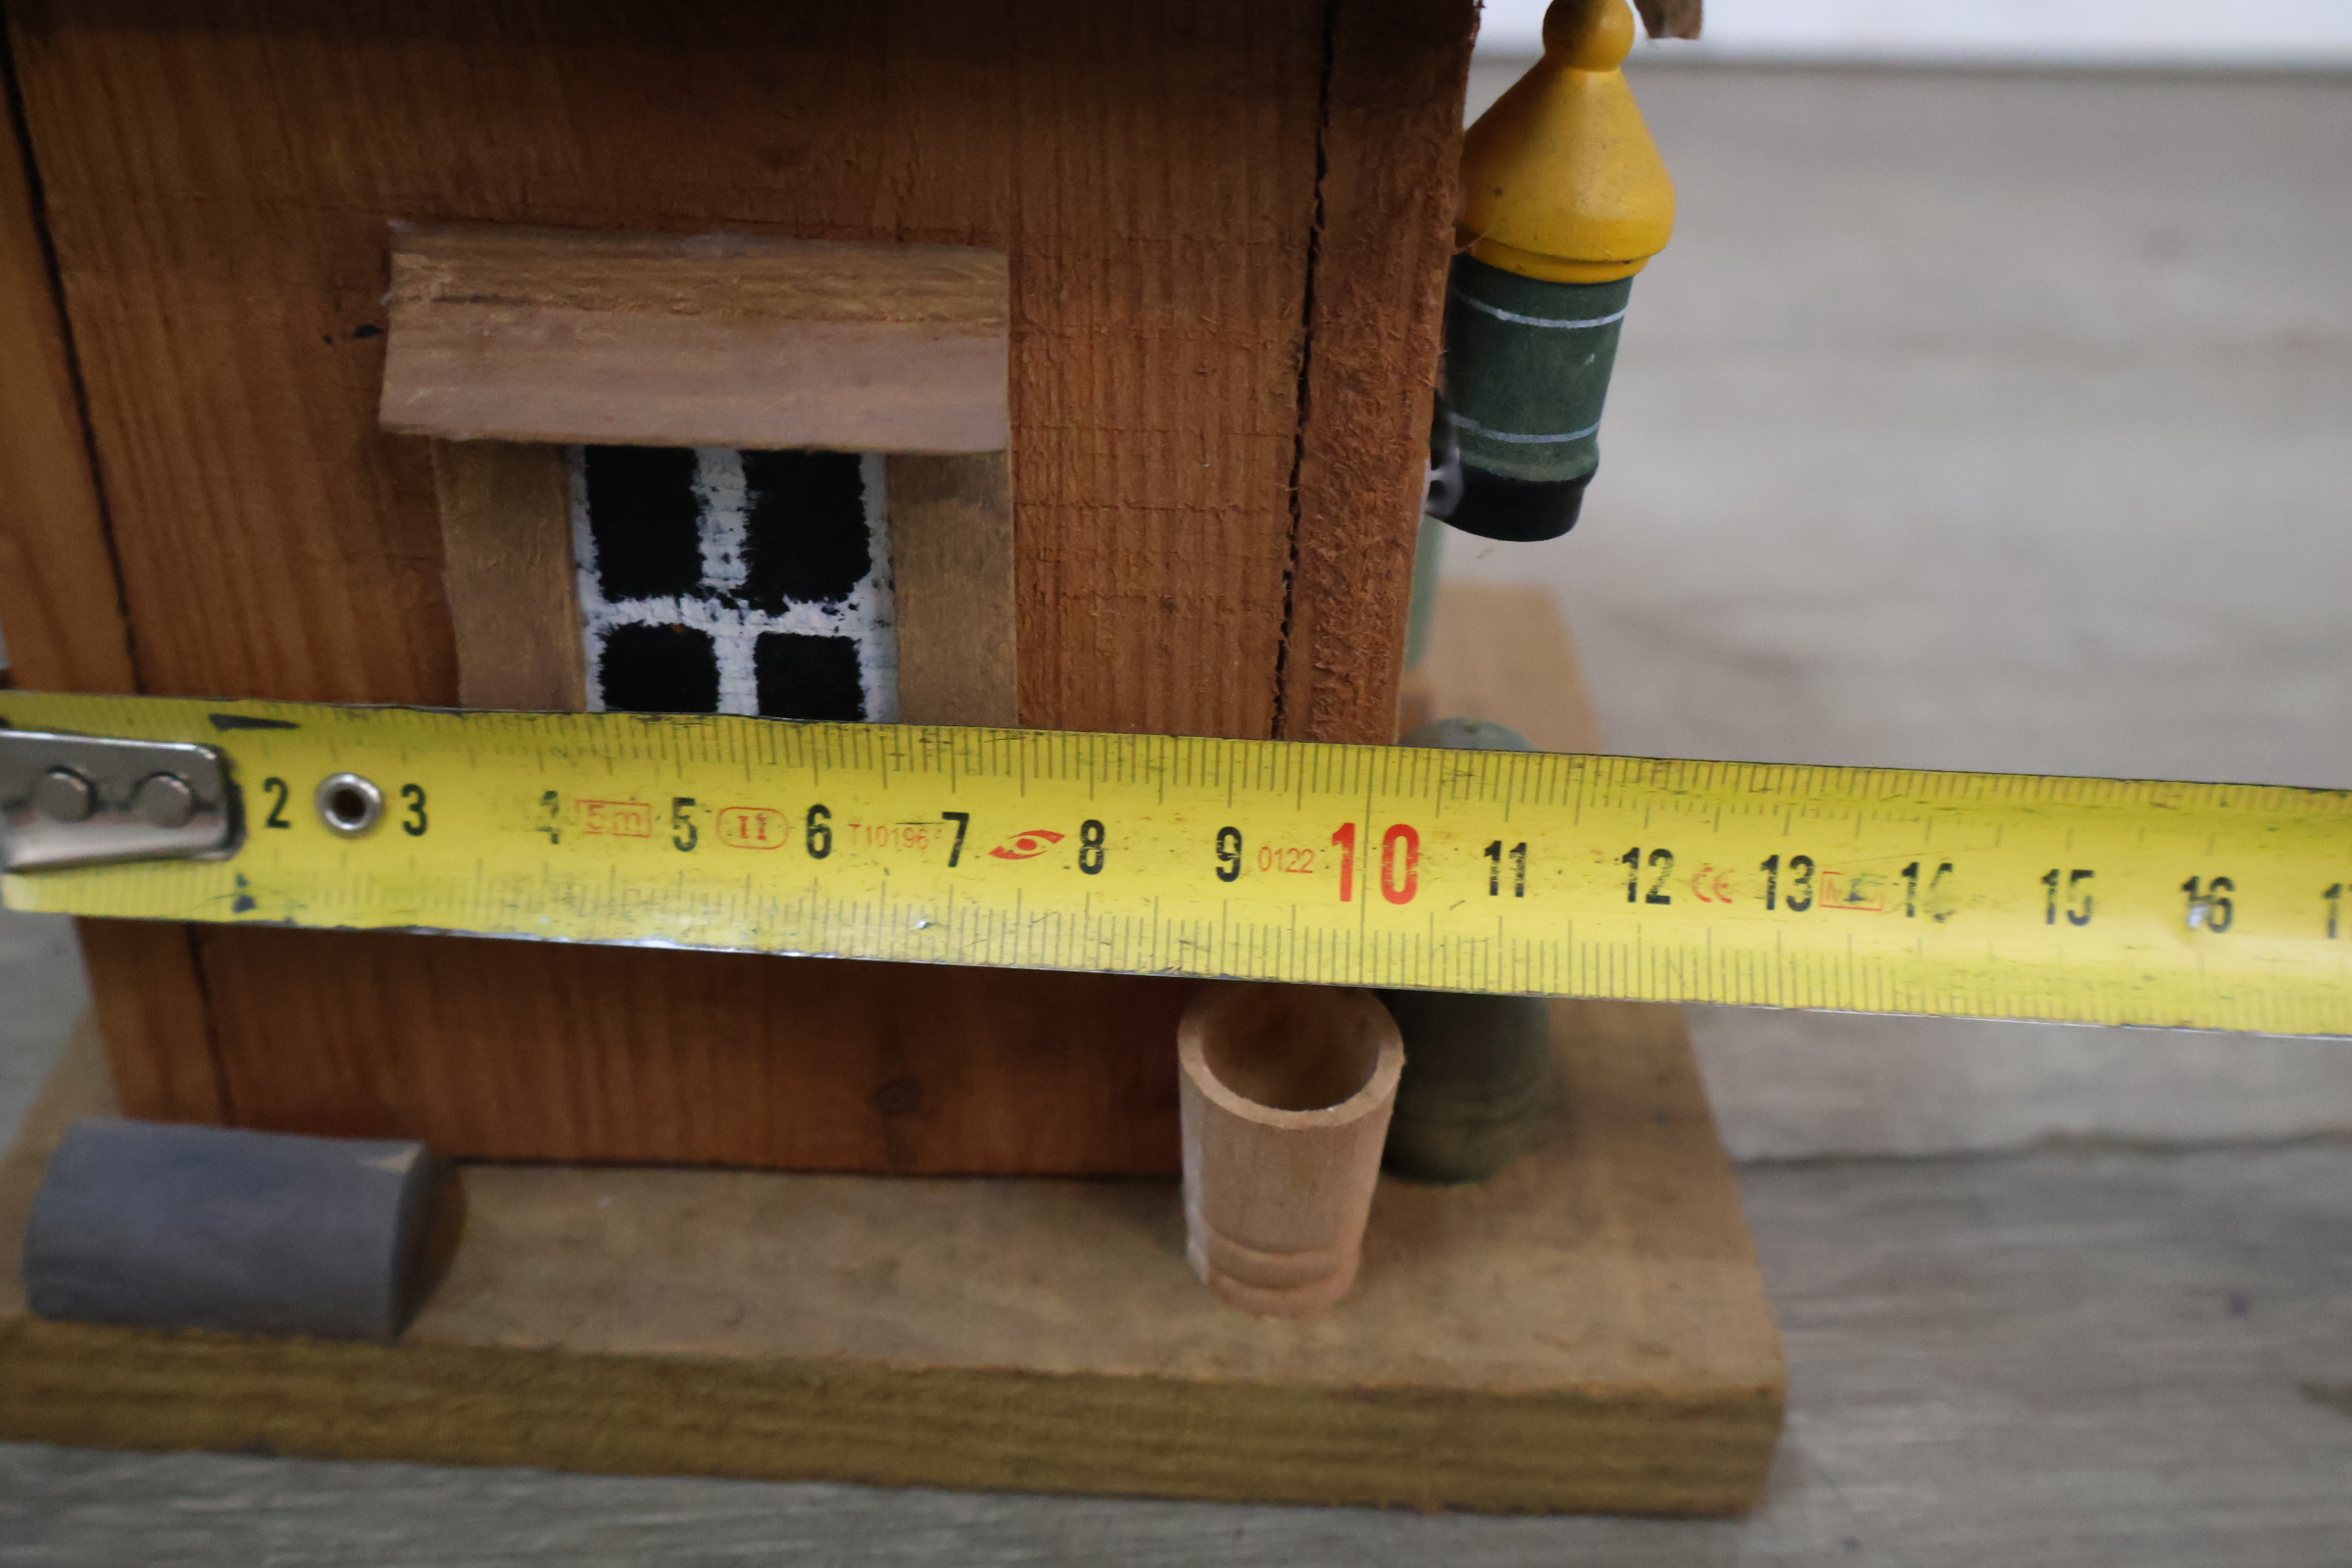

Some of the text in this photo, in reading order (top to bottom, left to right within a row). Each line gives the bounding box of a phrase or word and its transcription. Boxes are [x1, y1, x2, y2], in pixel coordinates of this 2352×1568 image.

[264, 777, 290, 829] 2
[401, 784, 428, 836] 3
[672, 797, 698, 853] 5
[807, 804, 832, 859] 6
[848, 823, 930, 850] T10196
[942, 811, 970, 868] 7
[1079, 819, 1105, 875] 8
[1216, 826, 1243, 883] 9
[1257, 846, 1315, 874] 0122
[1332, 822, 1420, 905] 10
[1484, 840, 1528, 898] 11
[1622, 847, 1674, 906] 12
[1760, 855, 1815, 911] 13
[2041, 868, 2095, 926] 15
[2181, 875, 2235, 934] 16
[2323, 883, 2352, 940] 1
